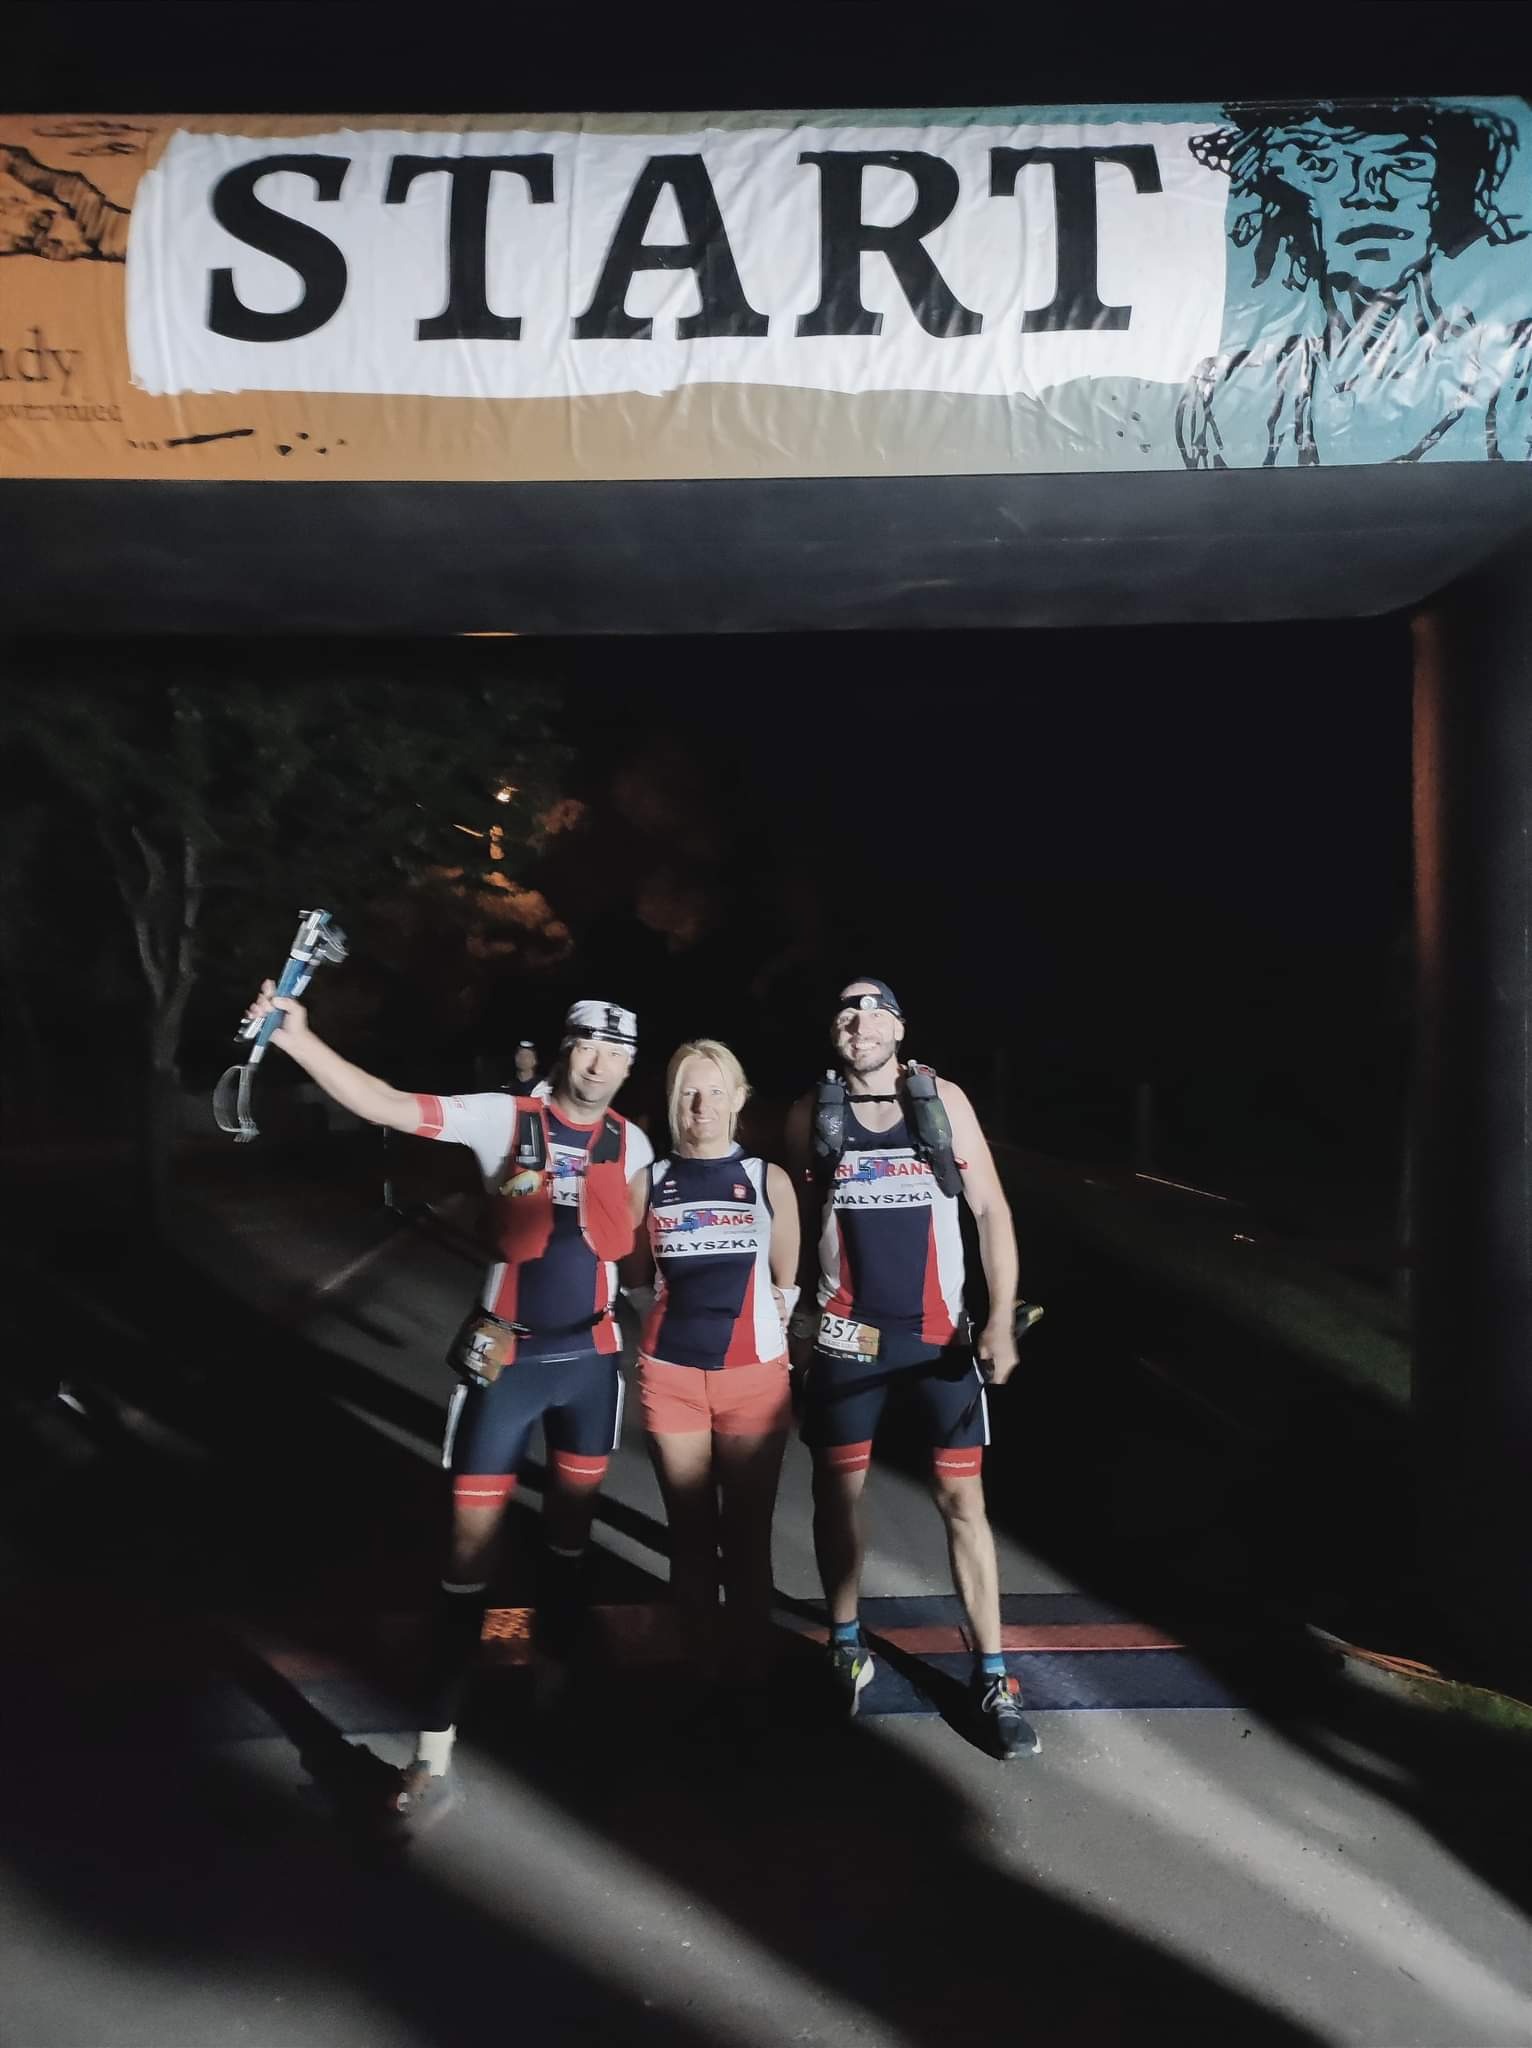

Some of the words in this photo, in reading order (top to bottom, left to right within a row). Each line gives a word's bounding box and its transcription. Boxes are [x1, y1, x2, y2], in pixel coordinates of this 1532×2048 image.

[206, 144, 1163, 343] START
[832, 1191, 933, 1206] MAŁYSZKA
[695, 1211, 755, 1228] TRANS
[655, 1238, 758, 1254] MAŁYSZKA
[821, 1315, 858, 1342] 257
